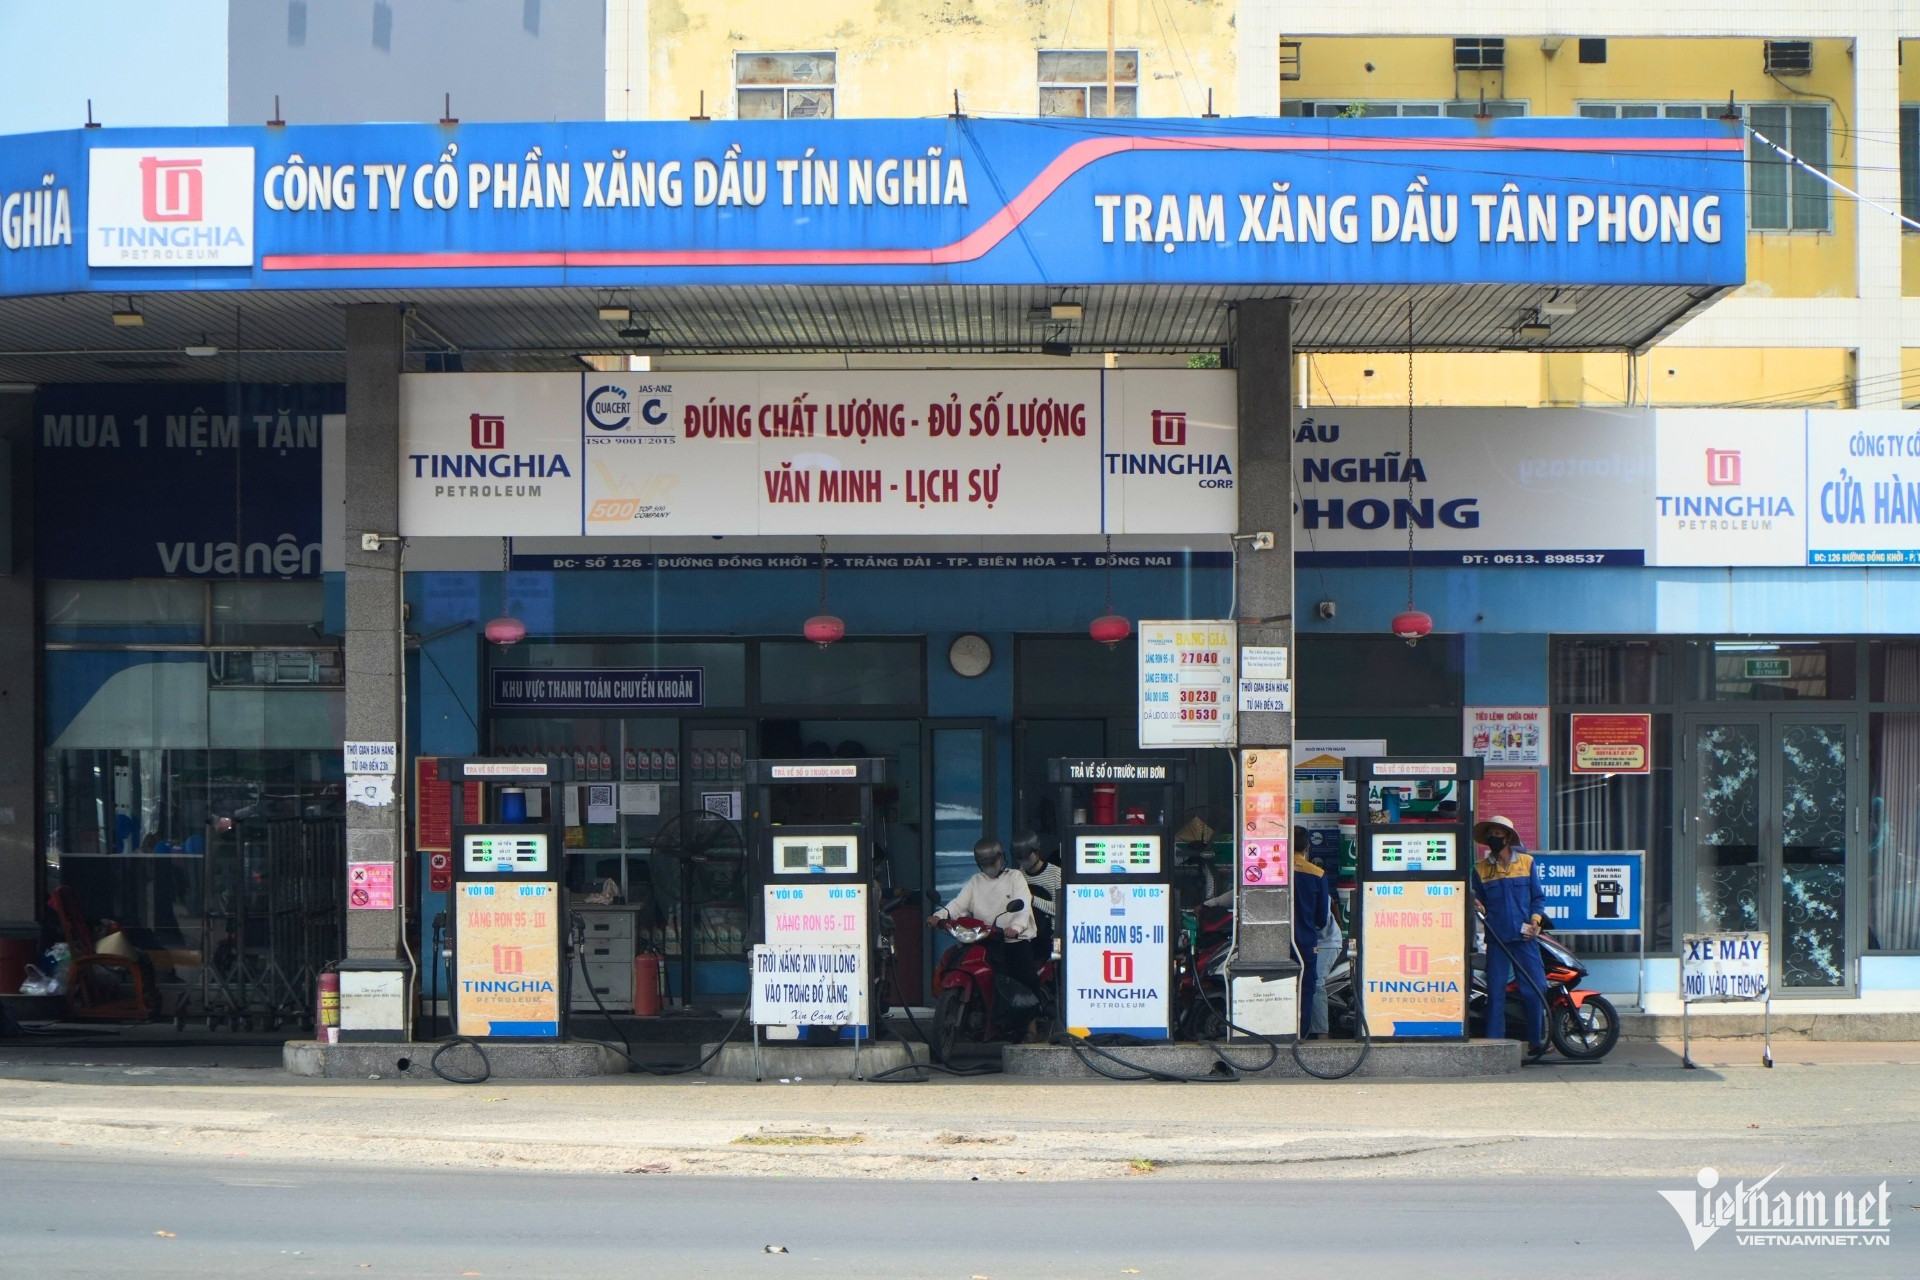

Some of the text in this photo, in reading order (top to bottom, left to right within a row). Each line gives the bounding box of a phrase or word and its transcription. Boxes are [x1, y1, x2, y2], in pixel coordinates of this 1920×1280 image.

[264, 142, 968, 211] CÔNG TY CỔ PHẦN XĂNG DẦU TÍN NGHĨA
[0, 174, 72, 250] GHĨA
[1094, 175, 1721, 254] TRẠM XĂNG DẦU TÂN PHONG
[98, 226, 245, 248] TINNGHIA
[120, 249, 219, 260] PETROLEUM
[596, 402, 630, 414] QUACERT
[684, 392, 1085, 444] ĐÚNG CHẤT LƯỢNG ĐỦ SỐ LƯỢNG
[44, 415, 120, 448] MUA
[134, 415, 148, 448] 1
[166, 407, 238, 456] NỆM
[1294, 418, 1339, 443] ẦU
[1850, 431, 1884, 457] CÔNG
[1888, 436, 1904, 456] TY
[409, 454, 570, 478] TINNGHIA
[1105, 453, 1231, 475] TINNGHIA
[1303, 452, 1426, 482] NGHĨA
[435, 485, 542, 498] PETROLEUM
[764, 462, 1001, 509] VĂN MINH LỊCH SỰ
[1199, 479, 1233, 489] CORP.
[1821, 467, 1865, 524] CỬA
[592, 503, 633, 518] 500
[1294, 498, 1479, 529] HONG
[1656, 497, 1795, 516] TINNGHIA
[1679, 520, 1772, 530] PETROLEUM
[585, 556, 606, 567] SỐ
[613, 559, 642, 567] 126
[658, 556, 713, 568] ĐƯỜNG
[719, 556, 763, 567] ĐỒNG
[769, 555, 807, 567] KHỞI
[844, 555, 896, 567] TRẢNG
[903, 554, 931, 567] DÀI
[947, 557, 972, 567] TP.
[978, 554, 1017, 566] BIÊN
[1023, 554, 1055, 566] HÒA
[1072, 557, 1086, 566] T.
[1145, 557, 1171, 566] NAI
[1462, 554, 1605, 564] ĐT: 0613. 898537
[1181, 653, 1217, 664] 27040
[502, 673, 693, 702] KHU VỰC THANH TOÁN CHUYỂN KHOẢN
[1181, 691, 1217, 702] 30230
[1181, 709, 1217, 720] 30530
[1071, 762, 1084, 778] TRẢ
[1086, 762, 1095, 778] VỀ
[1096, 762, 1106, 778] SỐ
[1137, 767, 1148, 778] KHI
[1150, 766, 1165, 778] BƠM
[1549, 865, 1575, 877] SINH
[776, 888, 803, 899] VÒI 06
[829, 887, 856, 898] VÒI 05
[1078, 886, 1104, 898] VÒI 04
[1132, 886, 1159, 898] VÒI 03
[1377, 885, 1390, 895] VÒI
[1427, 885, 1453, 895] VÒI 01
[1564, 883, 1582, 897] PHÍ
[803, 915, 821, 931] RON
[824, 915, 835, 931] 95
[843, 915, 855, 930] III
[1072, 922, 1163, 944] XĂNG RON 95 III
[1688, 934, 1762, 960] XE MÁY
[758, 948, 855, 973] TRỜI NẮNG XIN VUI LÒNG
[462, 981, 554, 992] TINNGHIA
[765, 975, 848, 1003] VÀO TRONG ĐỔ XĂNG
[1368, 981, 1458, 992] TINNGHIA
[1686, 971, 1764, 995] MỜI VÀO TRONG
[1077, 988, 1158, 999] TINNGHIA
